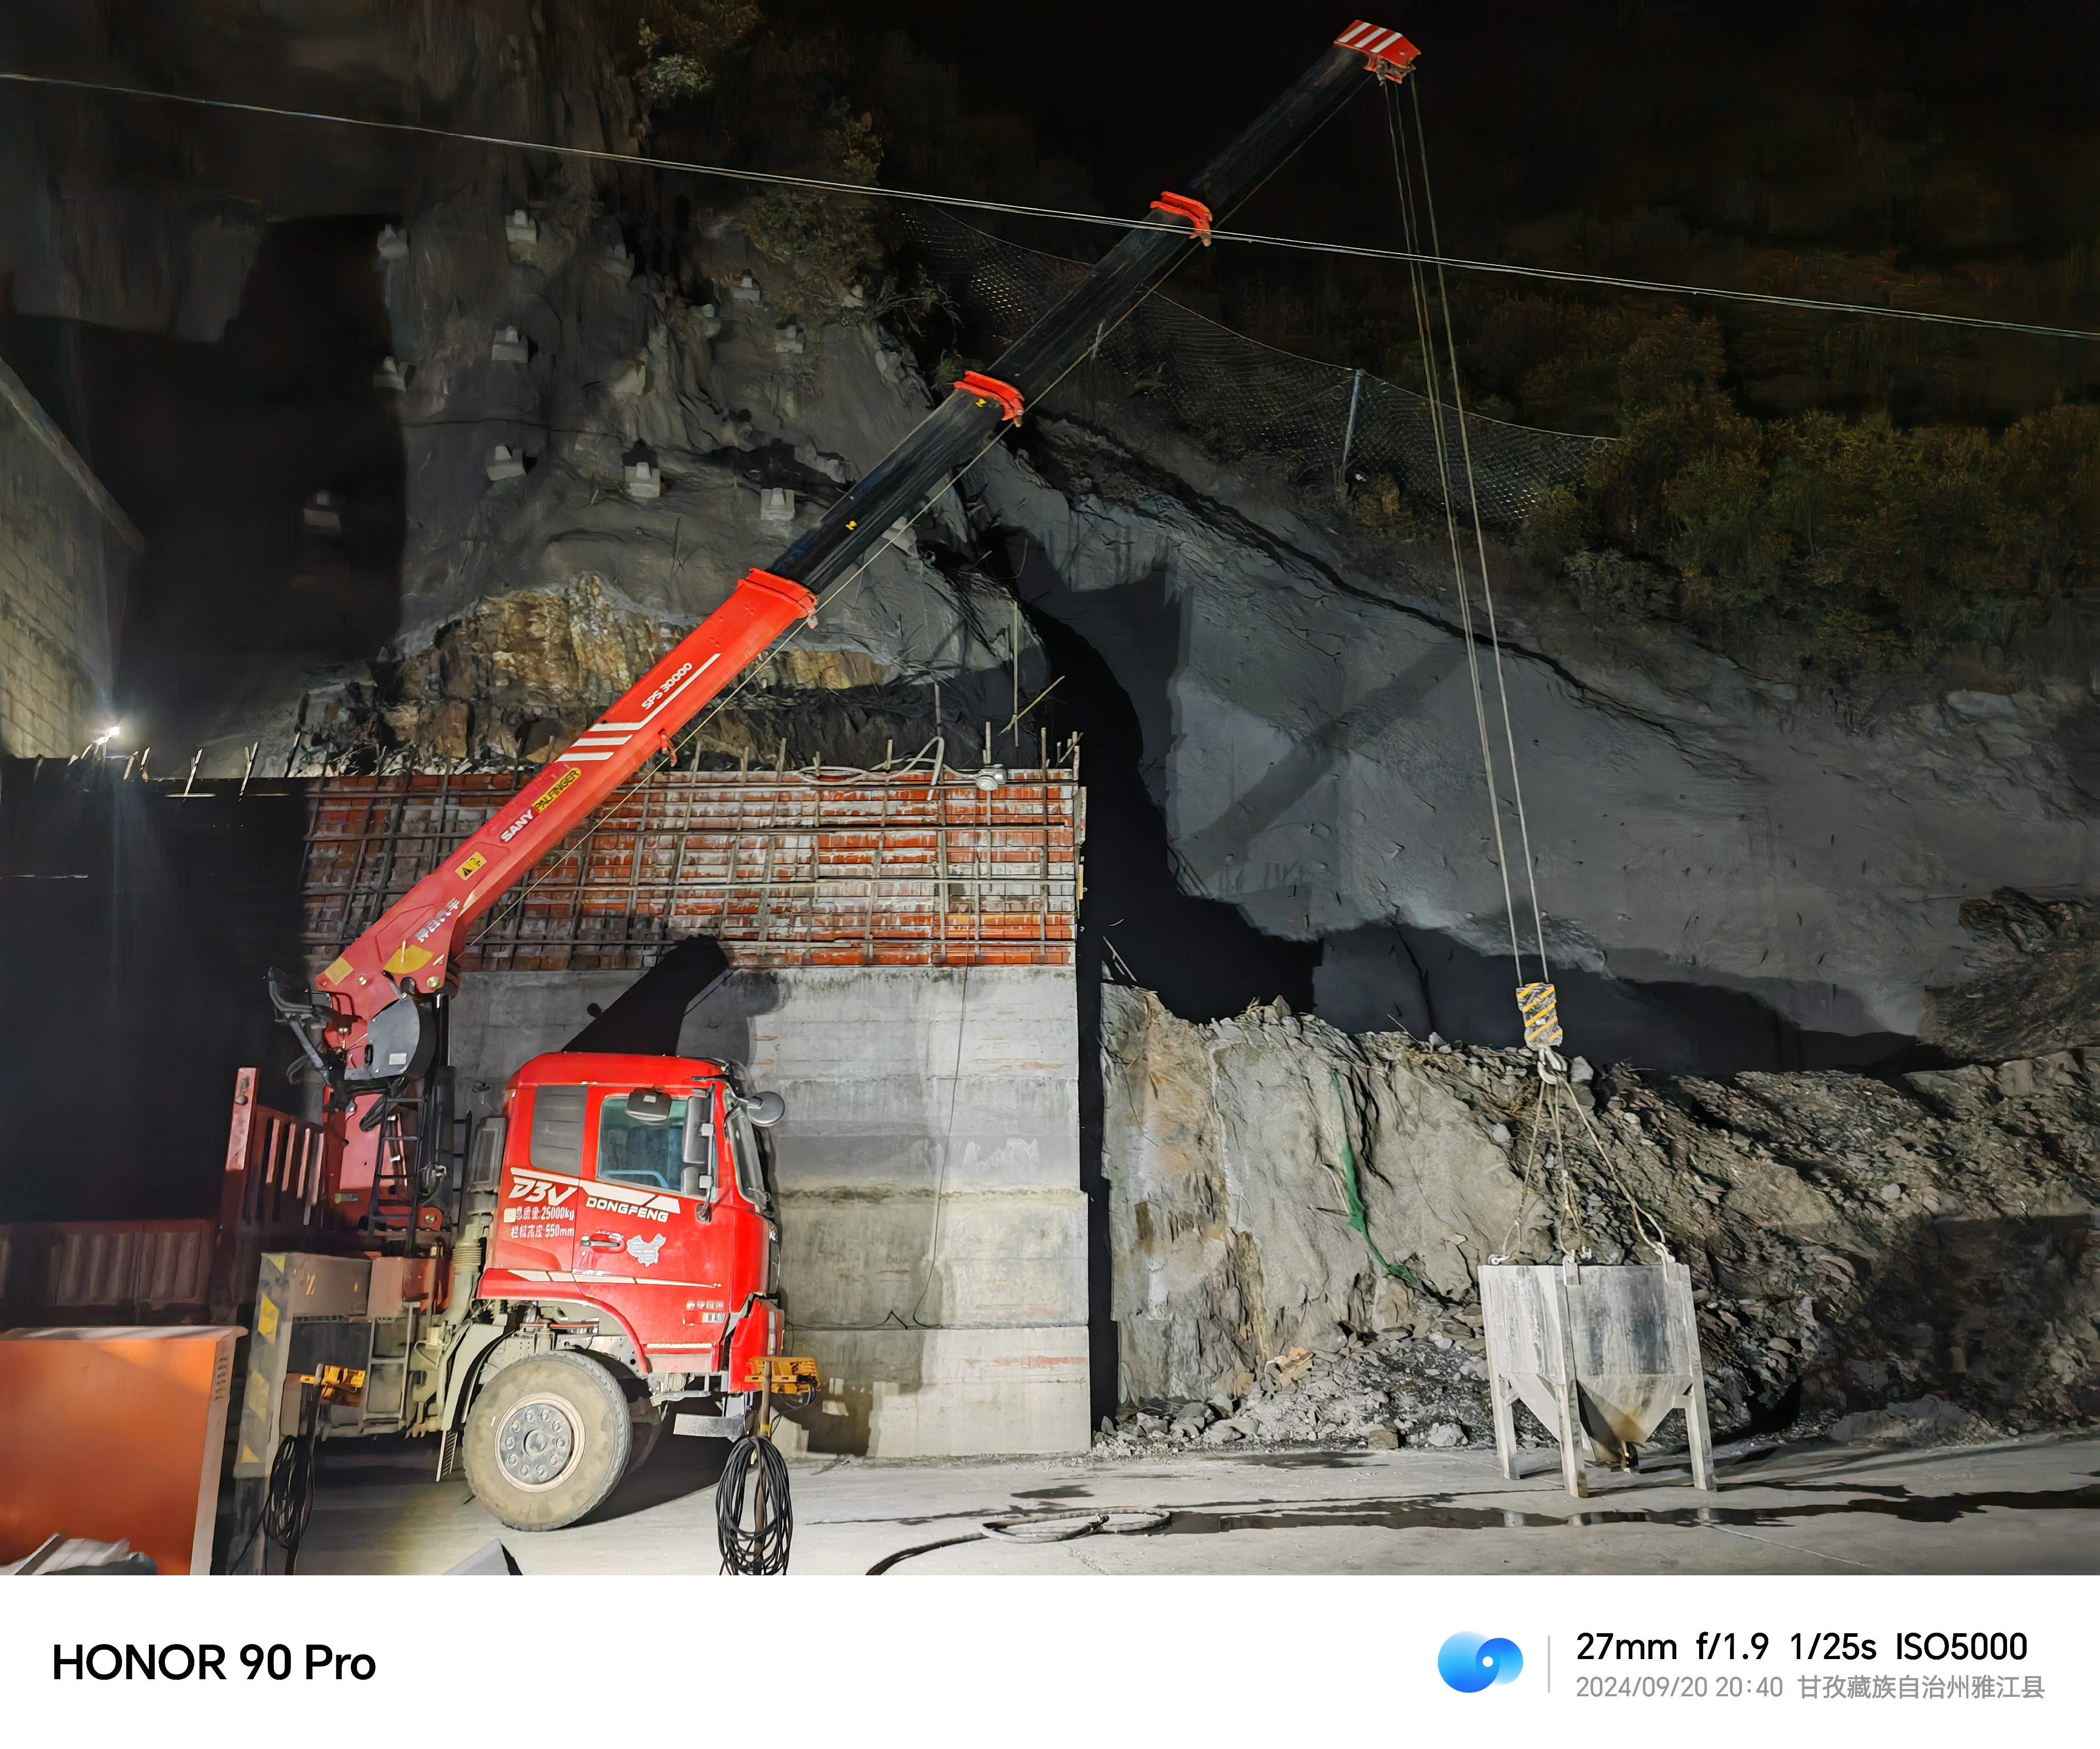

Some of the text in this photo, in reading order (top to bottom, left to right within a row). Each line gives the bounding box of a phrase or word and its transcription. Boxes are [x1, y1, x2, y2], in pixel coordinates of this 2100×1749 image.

[641, 663, 692, 710] SPS 30000
[500, 770, 579, 843] SANY PALFINGER
[586, 1196, 669, 1223] DONGFENG
